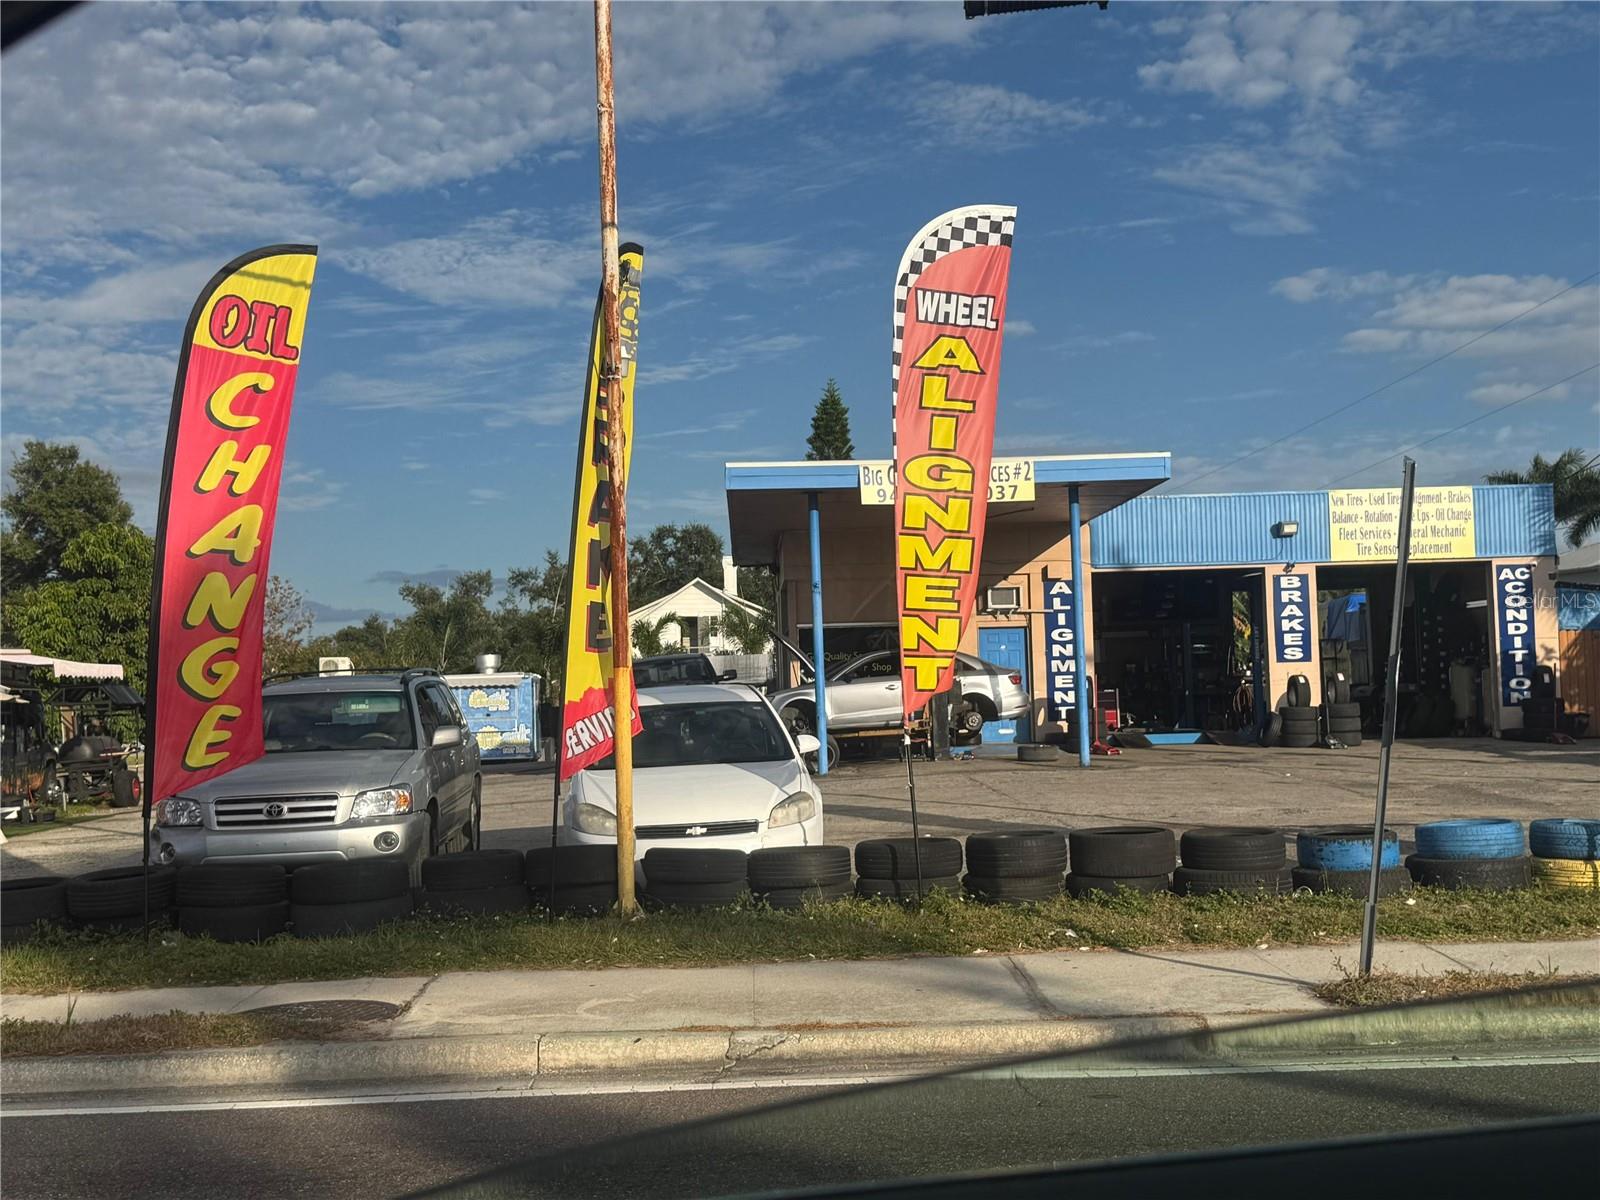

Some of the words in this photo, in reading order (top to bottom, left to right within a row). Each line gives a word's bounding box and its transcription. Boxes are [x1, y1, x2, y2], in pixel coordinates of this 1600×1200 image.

[209, 294, 299, 360] OIL
[915, 287, 998, 330] WHEEL
[898, 334, 986, 692] ALIGNMENT
[1332, 510, 1359, 524] Balance
[1364, 509, 1393, 523] Rotation
[1435, 508, 1445, 521] Oil
[1446, 508, 1472, 523] Change
[1346, 493, 1364, 506] Tires
[1368, 493, 1385, 506] Used
[1413, 491, 1443, 507] ignment
[1447, 490, 1471, 504] Brakes
[1338, 527, 1357, 541] Fleet
[1359, 526, 1392, 540] Services
[1410, 525, 1428, 538] eral
[1430, 524, 1467, 538] Mechanic
[1357, 542, 1372, 556] Tire
[1373, 542, 1398, 556] Senso
[1409, 541, 1453, 557] eplacement
[177, 372, 275, 771] CHANGE
[1499, 568, 1530, 580] AC
[1280, 576, 1305, 660] BRAKES
[1049, 581, 1076, 720] ALIGNMENT
[1504, 581, 1531, 704] CONDITION
[872, 662, 892, 673] Shop
